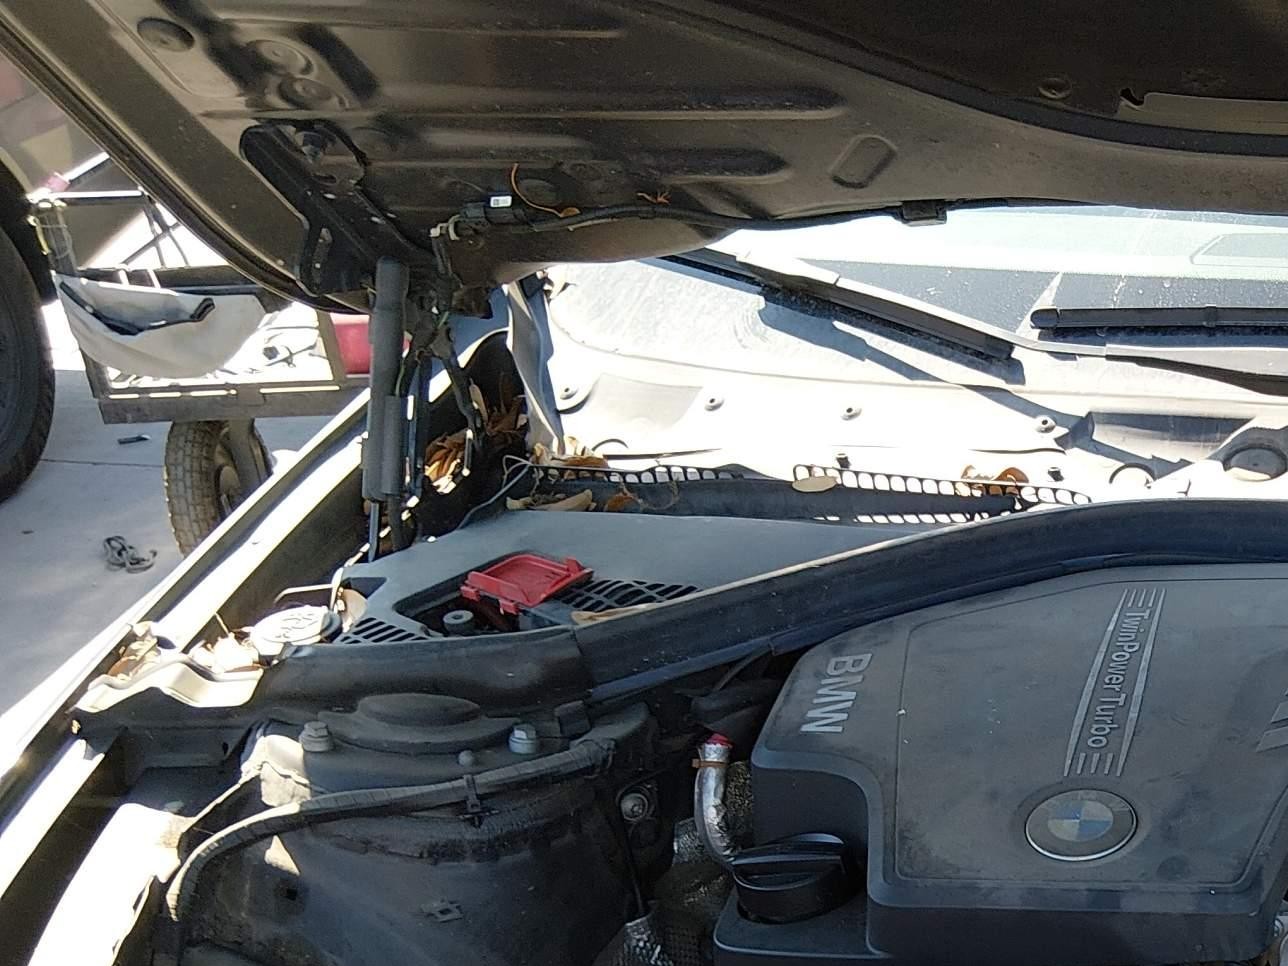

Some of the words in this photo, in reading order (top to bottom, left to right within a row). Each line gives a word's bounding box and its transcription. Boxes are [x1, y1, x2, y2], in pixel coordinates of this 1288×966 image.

[1103, 608, 1151, 692] TwinPower
[800, 653, 873, 733] BMW
[1087, 693, 1127, 748] Turbo
